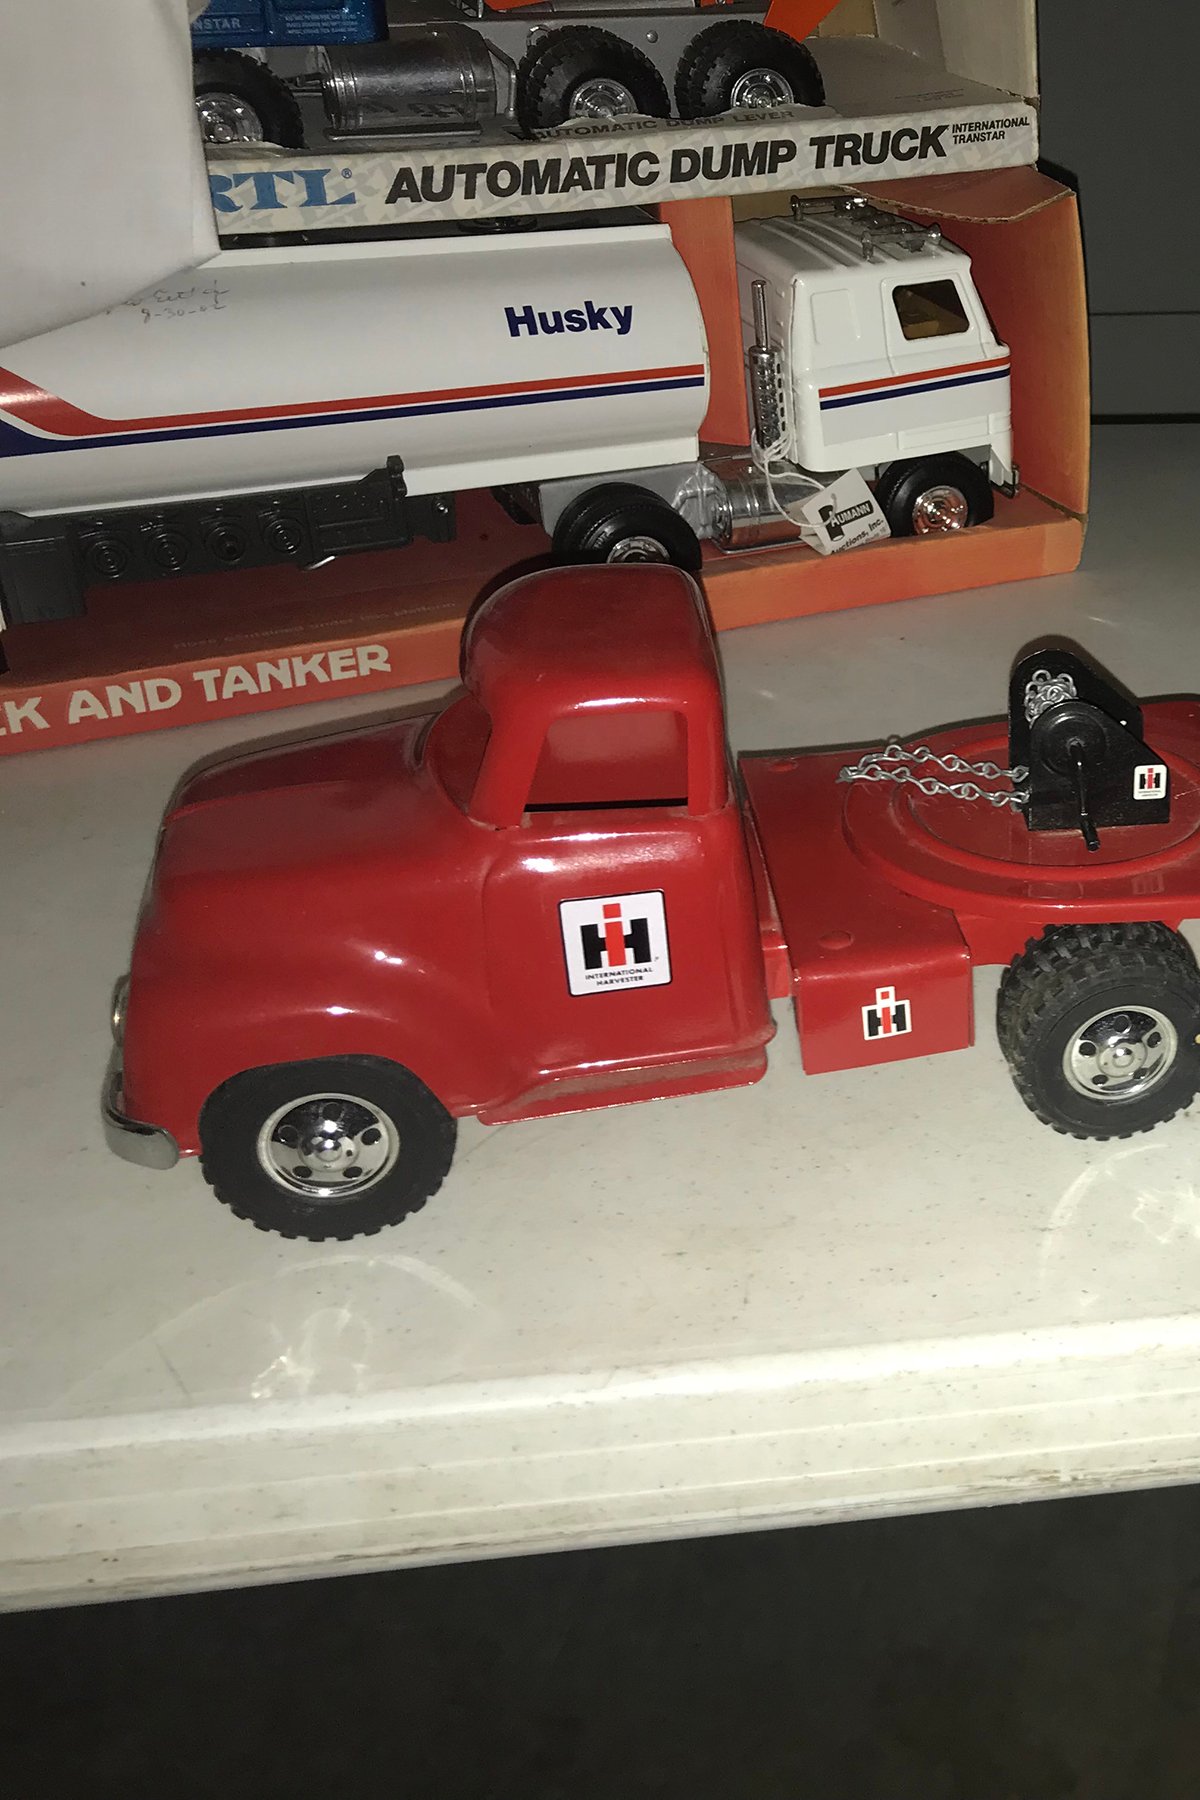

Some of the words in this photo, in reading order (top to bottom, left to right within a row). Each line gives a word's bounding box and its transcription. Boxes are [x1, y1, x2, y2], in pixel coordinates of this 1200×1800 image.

[733, 110, 794, 122] LEVER
[952, 116, 1030, 134] INTERNATIONAL
[952, 130, 1006, 145] TRANSTAR
[385, 151, 660, 204] AUTOMATIC
[670, 139, 797, 183] DUMP
[809, 124, 949, 169] TRUCK
[504, 300, 632, 337] Husky
[68, 678, 182, 724] AND
[193, 644, 391, 702] TANKER
[585, 967, 653, 980] INTERNATIONAL
[596, 976, 643, 986] HARVESTER
